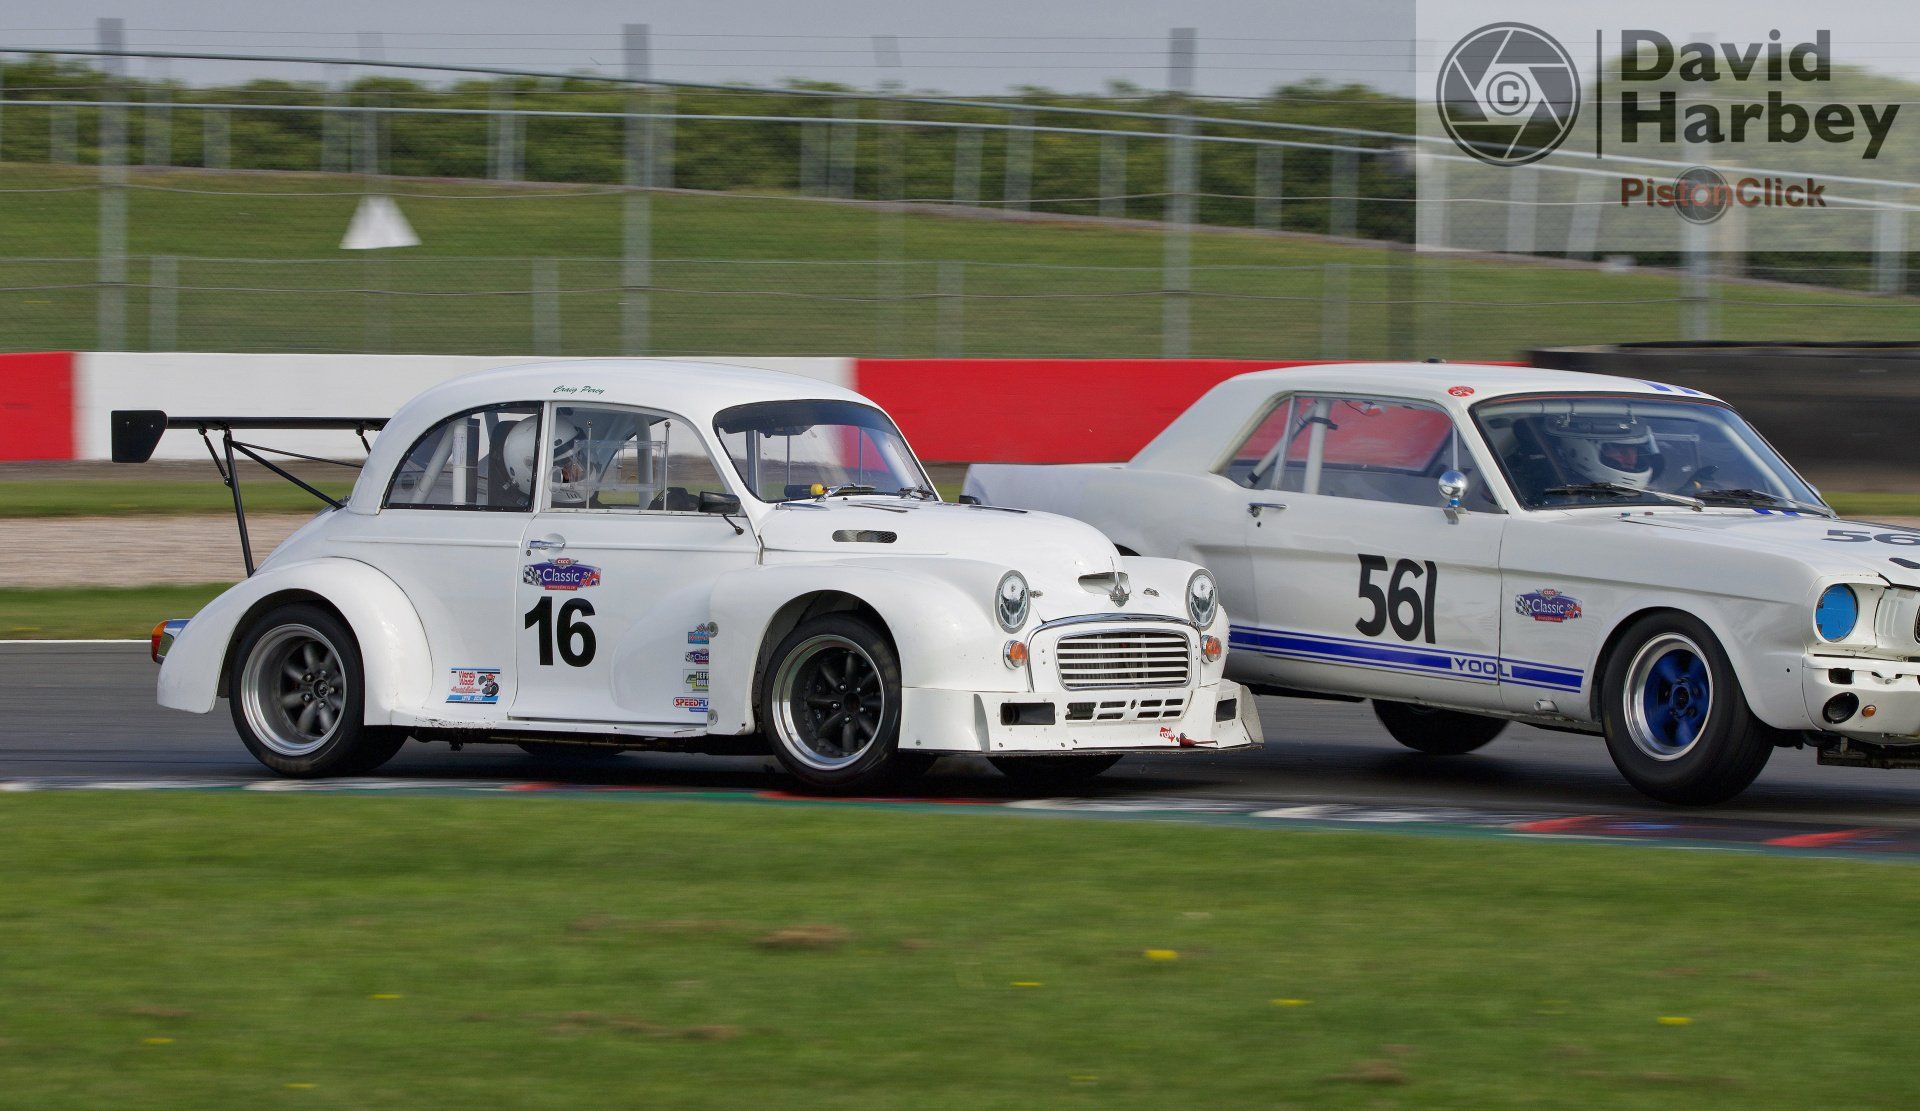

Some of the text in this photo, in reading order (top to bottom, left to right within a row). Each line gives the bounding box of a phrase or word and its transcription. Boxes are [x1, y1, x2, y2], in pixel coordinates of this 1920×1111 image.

[553, 385, 605, 395] Craig Percy
[543, 568, 579, 582] Classic
[1355, 553, 1437, 645] 561
[1532, 599, 1563, 613] Classic
[525, 596, 596, 667] 16
[1454, 656, 1511, 678] YOOL
